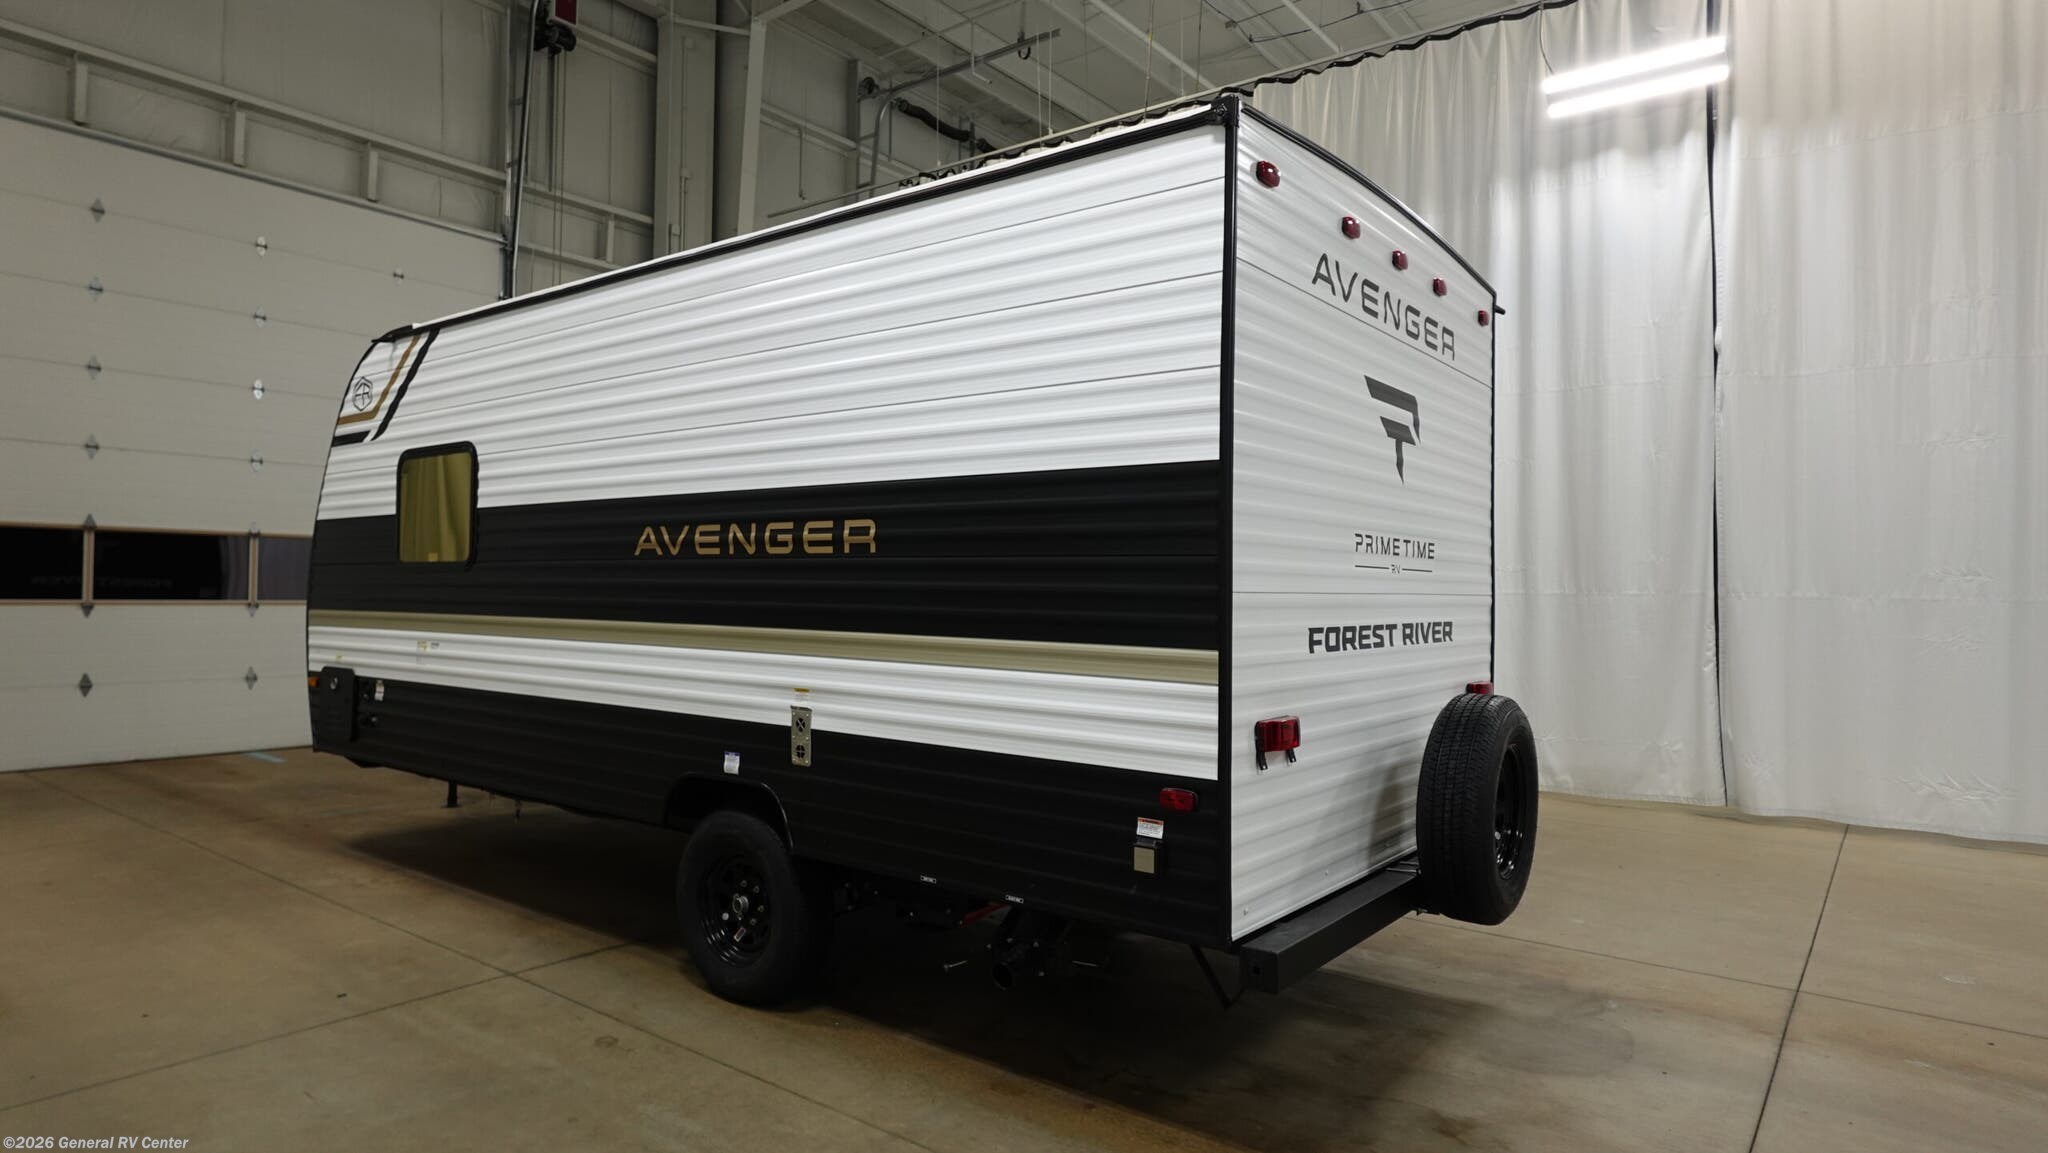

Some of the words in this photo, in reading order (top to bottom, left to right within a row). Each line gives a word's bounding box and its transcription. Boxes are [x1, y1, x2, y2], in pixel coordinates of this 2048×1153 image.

[1312, 253, 1455, 361] AVENGER
[634, 519, 877, 556] AVENGER
[1308, 624, 1398, 654] FOREST
[1402, 621, 1454, 646] RIVER
